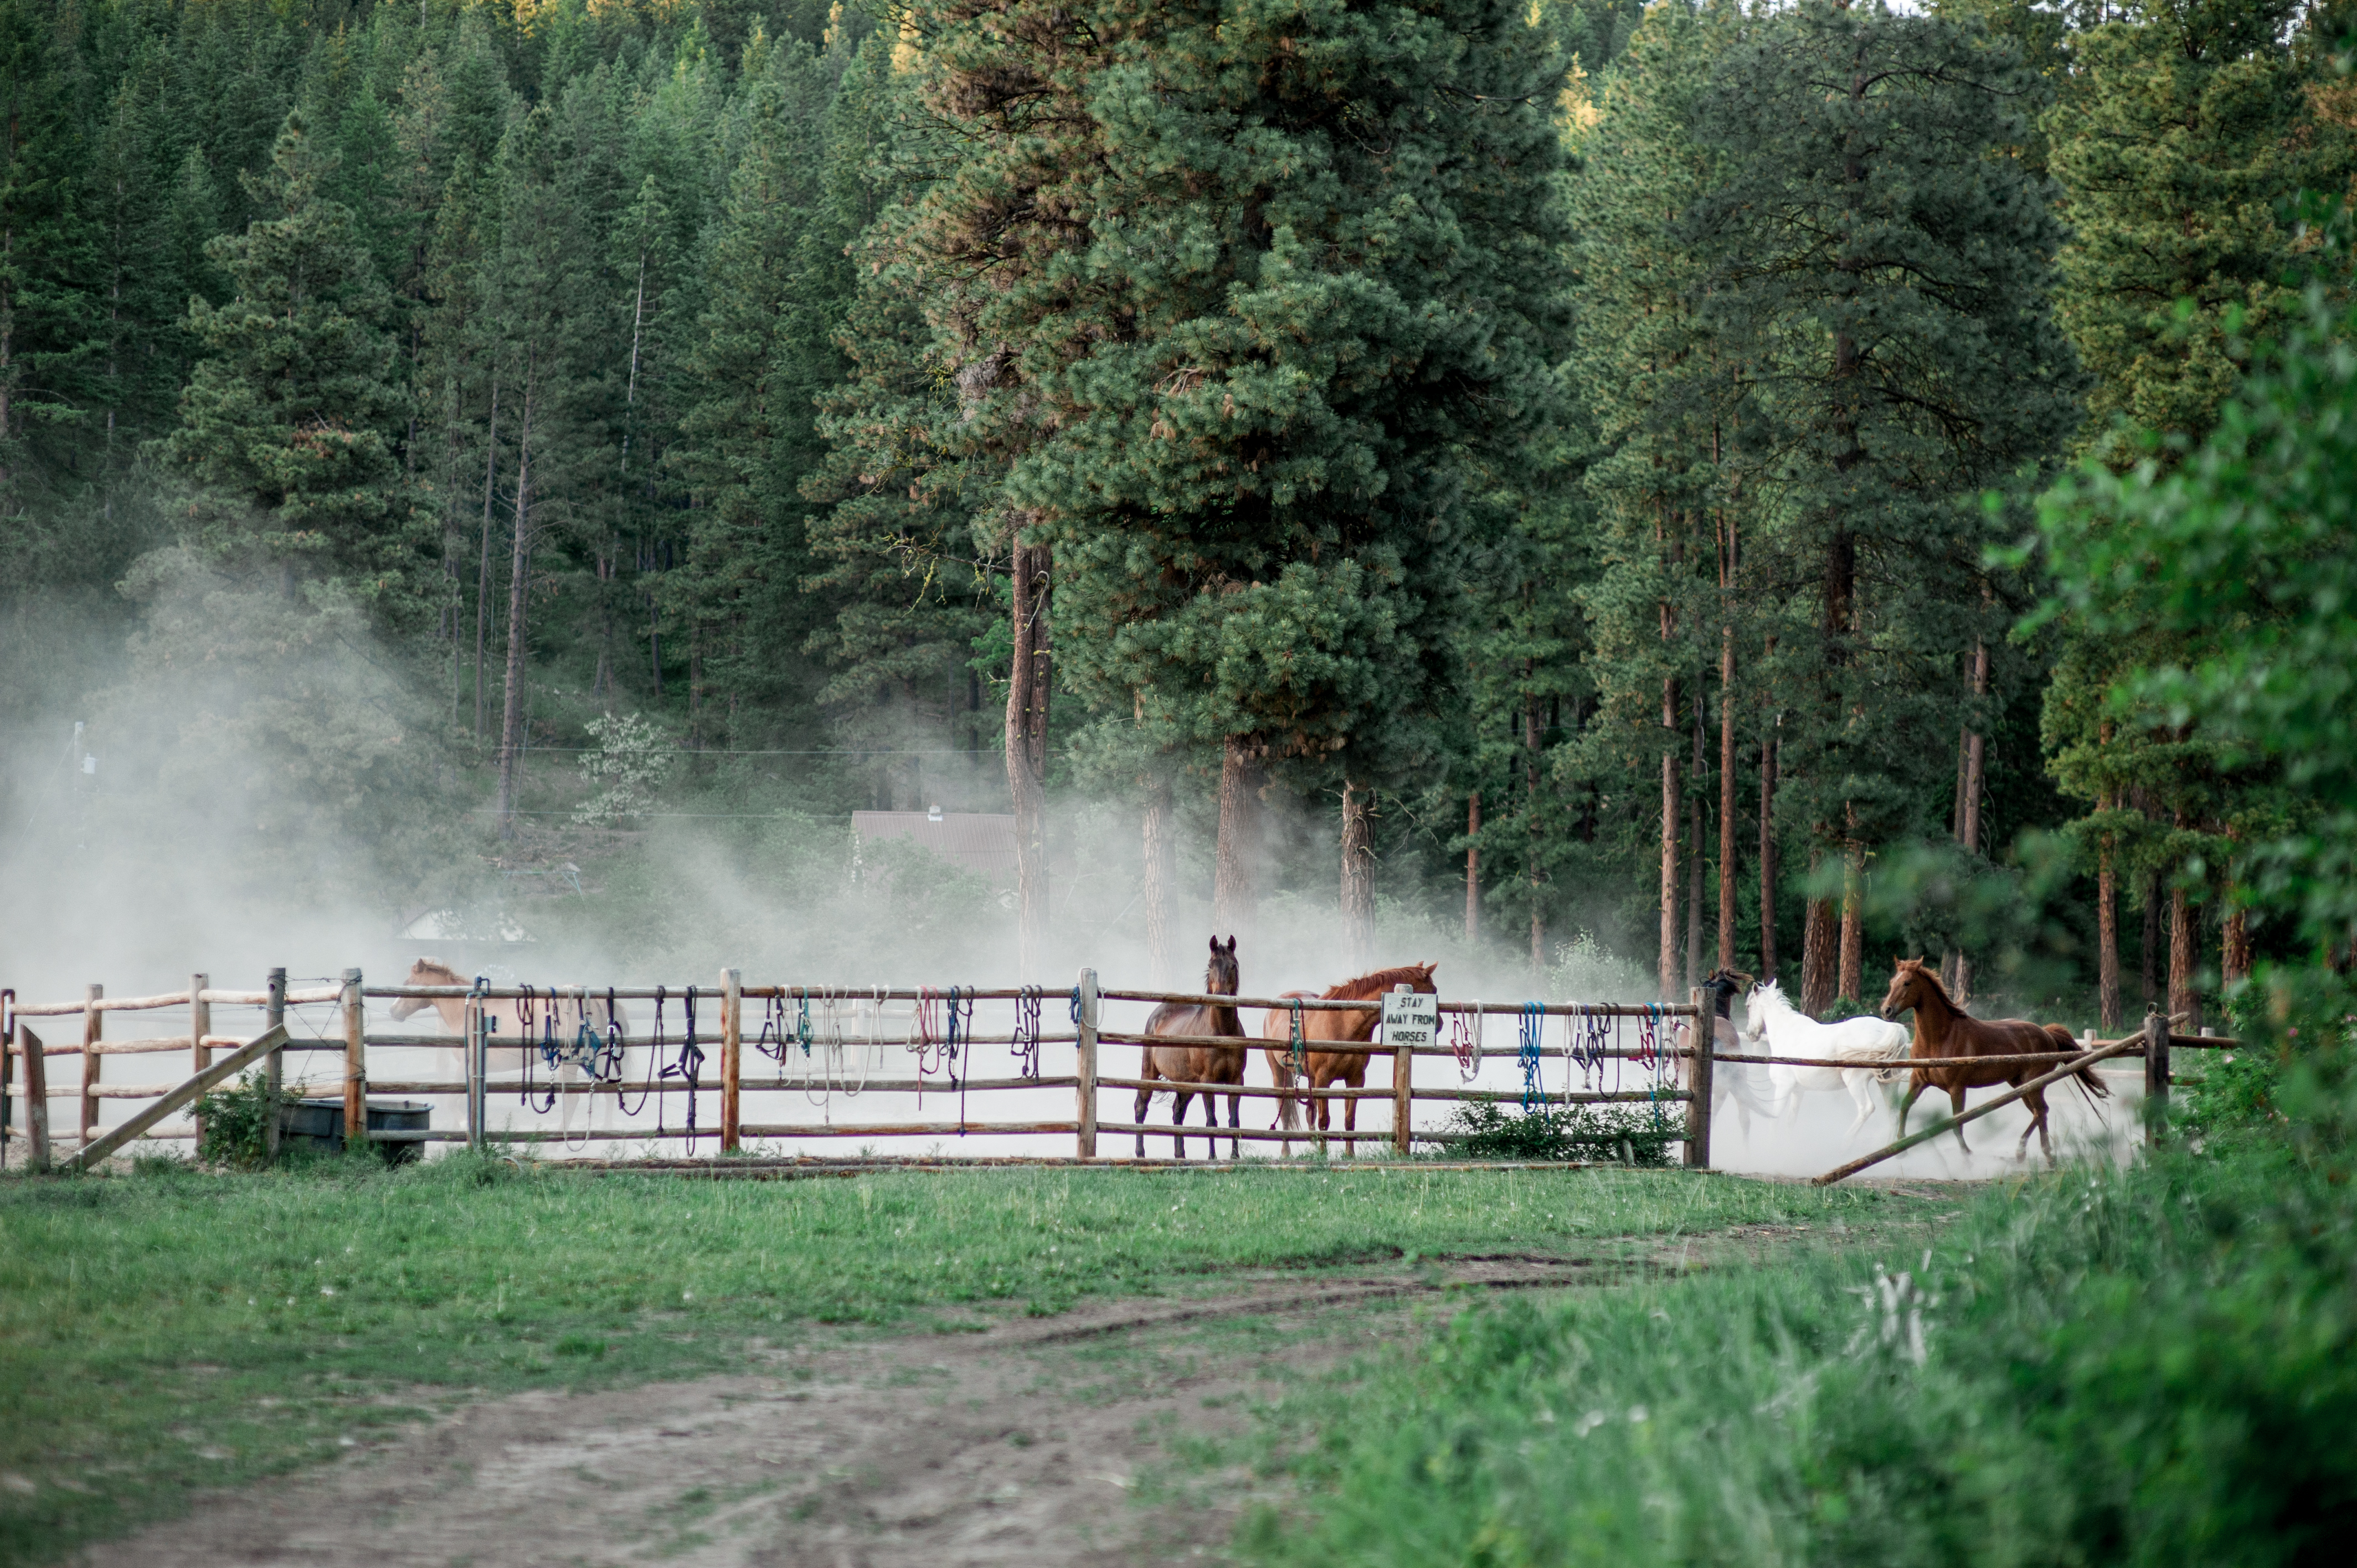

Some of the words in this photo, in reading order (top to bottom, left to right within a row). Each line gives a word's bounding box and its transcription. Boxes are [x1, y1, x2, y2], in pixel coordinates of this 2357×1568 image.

[1401, 997, 1423, 1008] STAY
[1386, 1014, 1408, 1024] AWAY
[1412, 1014, 1435, 1024] FROM
[1392, 1031, 1427, 1041] HORSES
